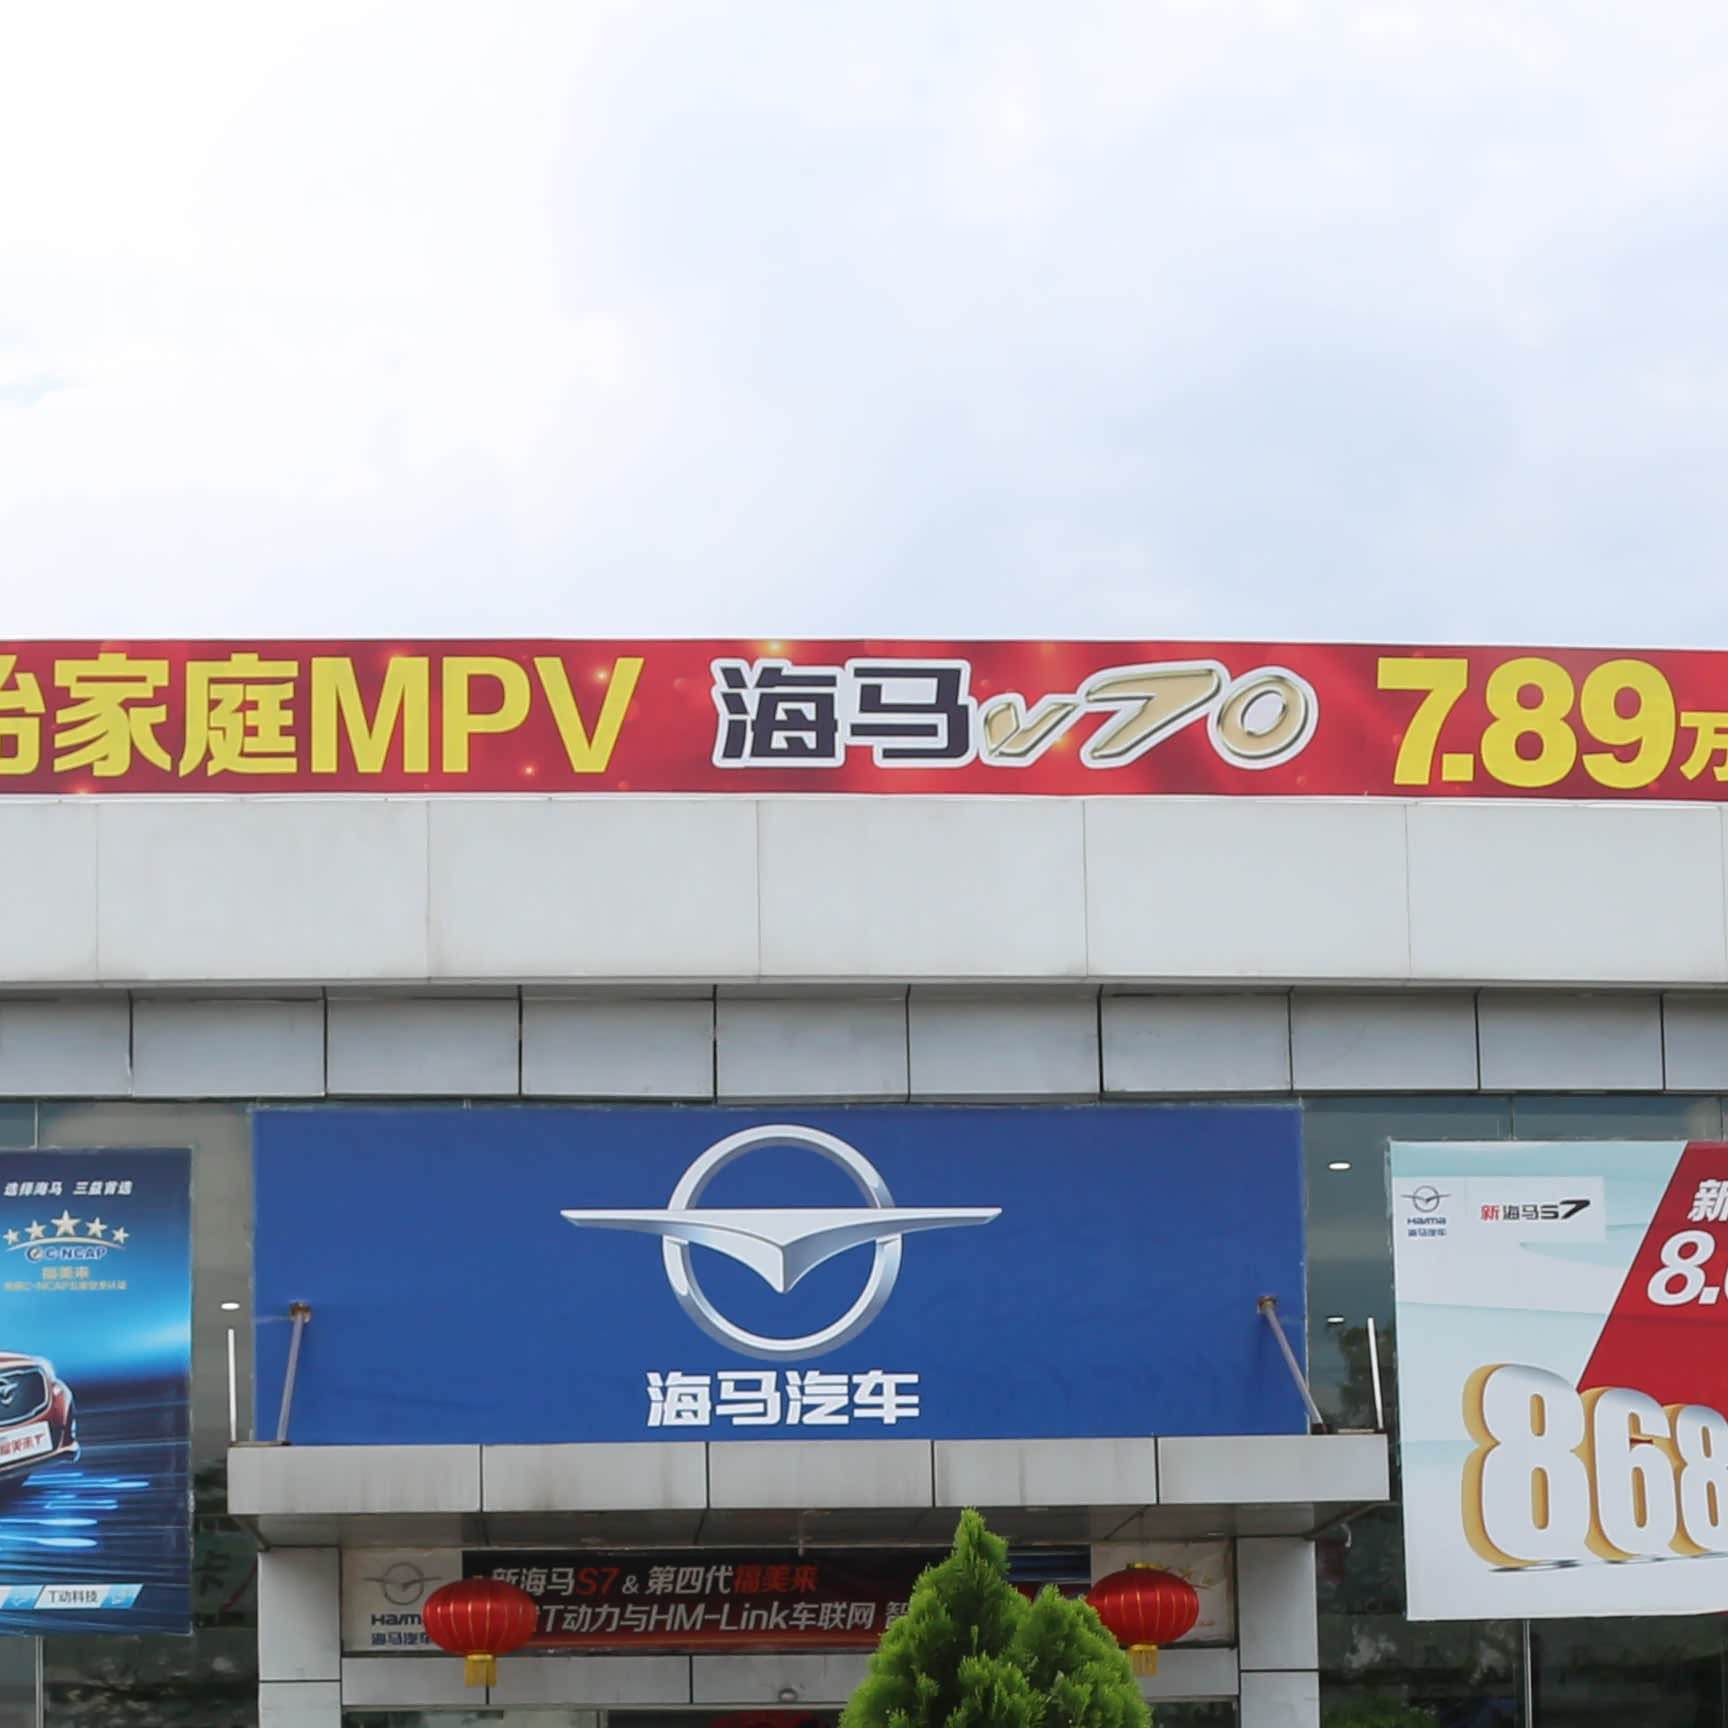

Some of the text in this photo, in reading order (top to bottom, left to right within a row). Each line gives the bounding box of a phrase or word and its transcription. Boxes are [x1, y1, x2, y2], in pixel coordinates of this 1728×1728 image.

[1480, 1199, 1592, 1221] 新海马S7
[646, 1368, 922, 1428] 海马汽车
[645, 1564, 818, 1595] 第四代福美来
[534, 1602, 875, 1633] T动力与HM-Link车联网
